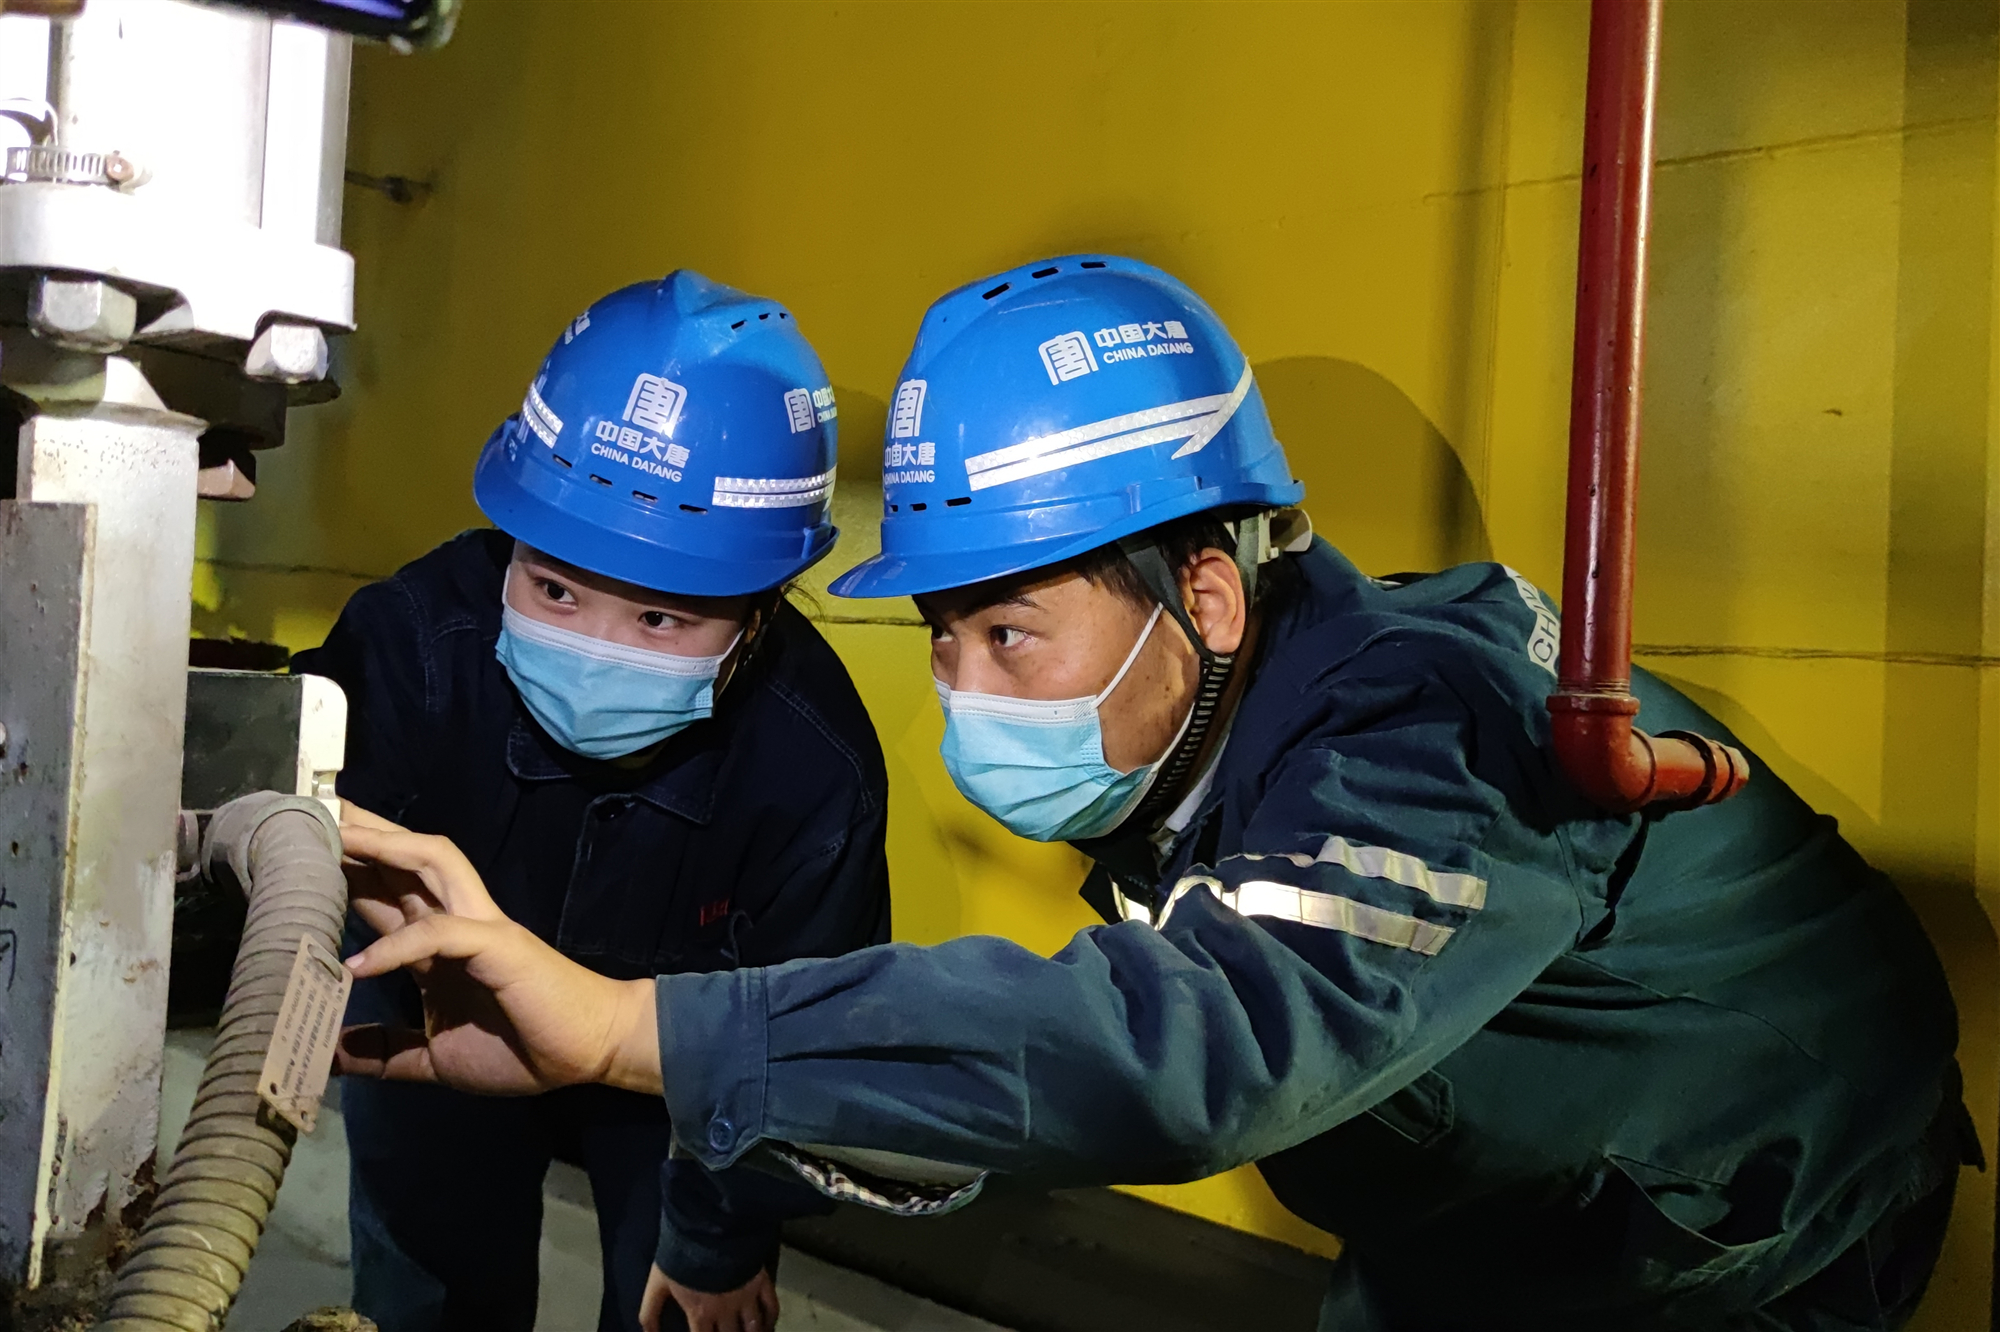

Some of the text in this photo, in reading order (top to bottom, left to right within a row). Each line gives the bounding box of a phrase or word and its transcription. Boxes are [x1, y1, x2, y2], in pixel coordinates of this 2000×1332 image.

[1094, 320, 1188, 347] 中国大唐
[1103, 342, 1194, 364] CHINA DATANG
[595, 420, 691, 468] 中国大唐
[884, 442, 936, 469] 中国大唐
[591, 443, 682, 482] CHINA DATANG
[900, 470, 936, 483] DATANG
